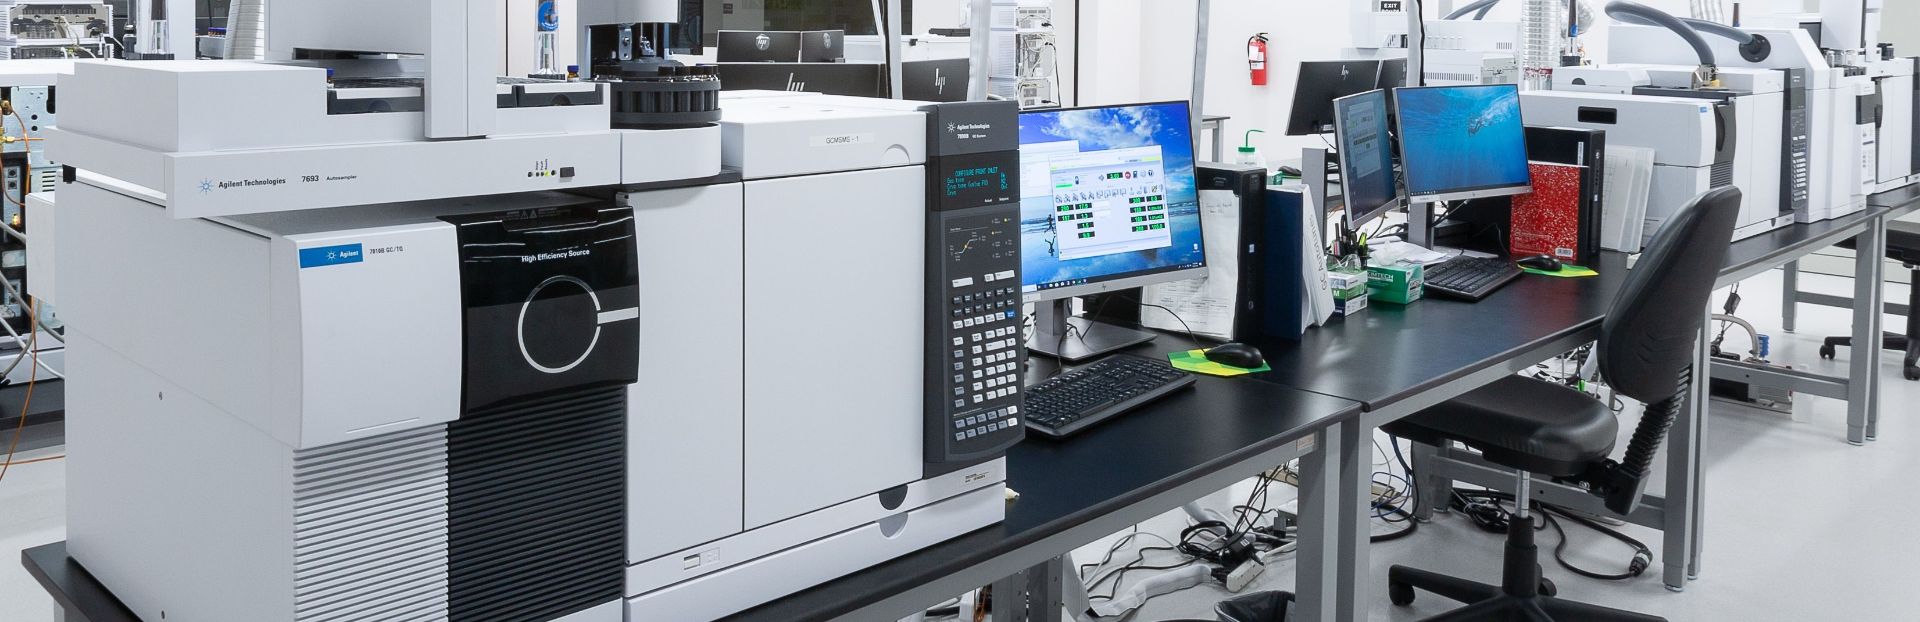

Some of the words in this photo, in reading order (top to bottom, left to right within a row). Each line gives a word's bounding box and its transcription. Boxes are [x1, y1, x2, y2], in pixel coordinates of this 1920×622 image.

[935, 68, 946, 94] hp
[218, 180, 243, 189] Agilent
[243, 177, 287, 187] Technologies
[301, 174, 320, 183] 7693
[340, 250, 359, 259] Agilent
[521, 255, 537, 263] High
[537, 252, 568, 261] Efficiency
[568, 249, 590, 257] Source
